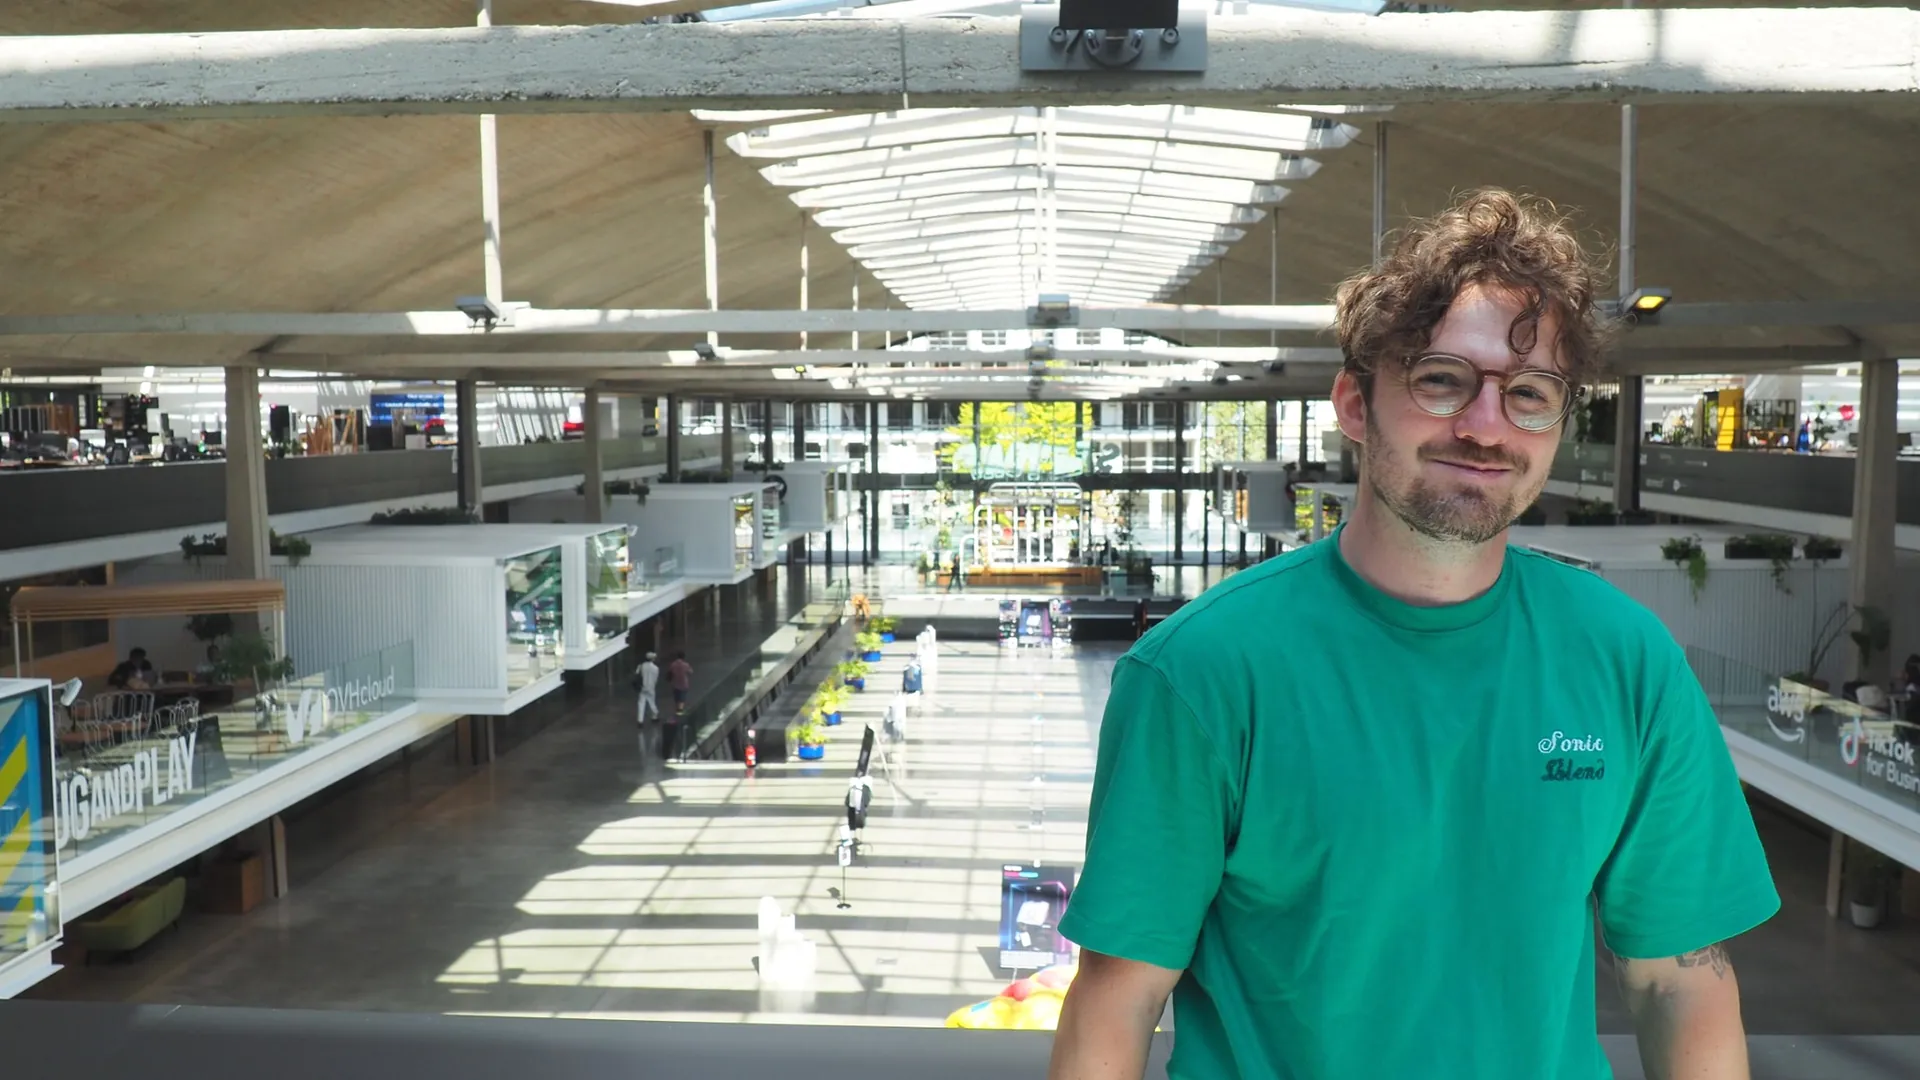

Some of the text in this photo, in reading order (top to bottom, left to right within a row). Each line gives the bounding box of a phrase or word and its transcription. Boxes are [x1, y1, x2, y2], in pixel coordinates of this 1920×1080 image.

[325, 665, 394, 719] OVHcloud
[1768, 685, 1804, 722] aws
[1538, 731, 1604, 753] Sonic
[1867, 729, 1914, 766] TikTok
[1866, 752, 1884, 777] for
